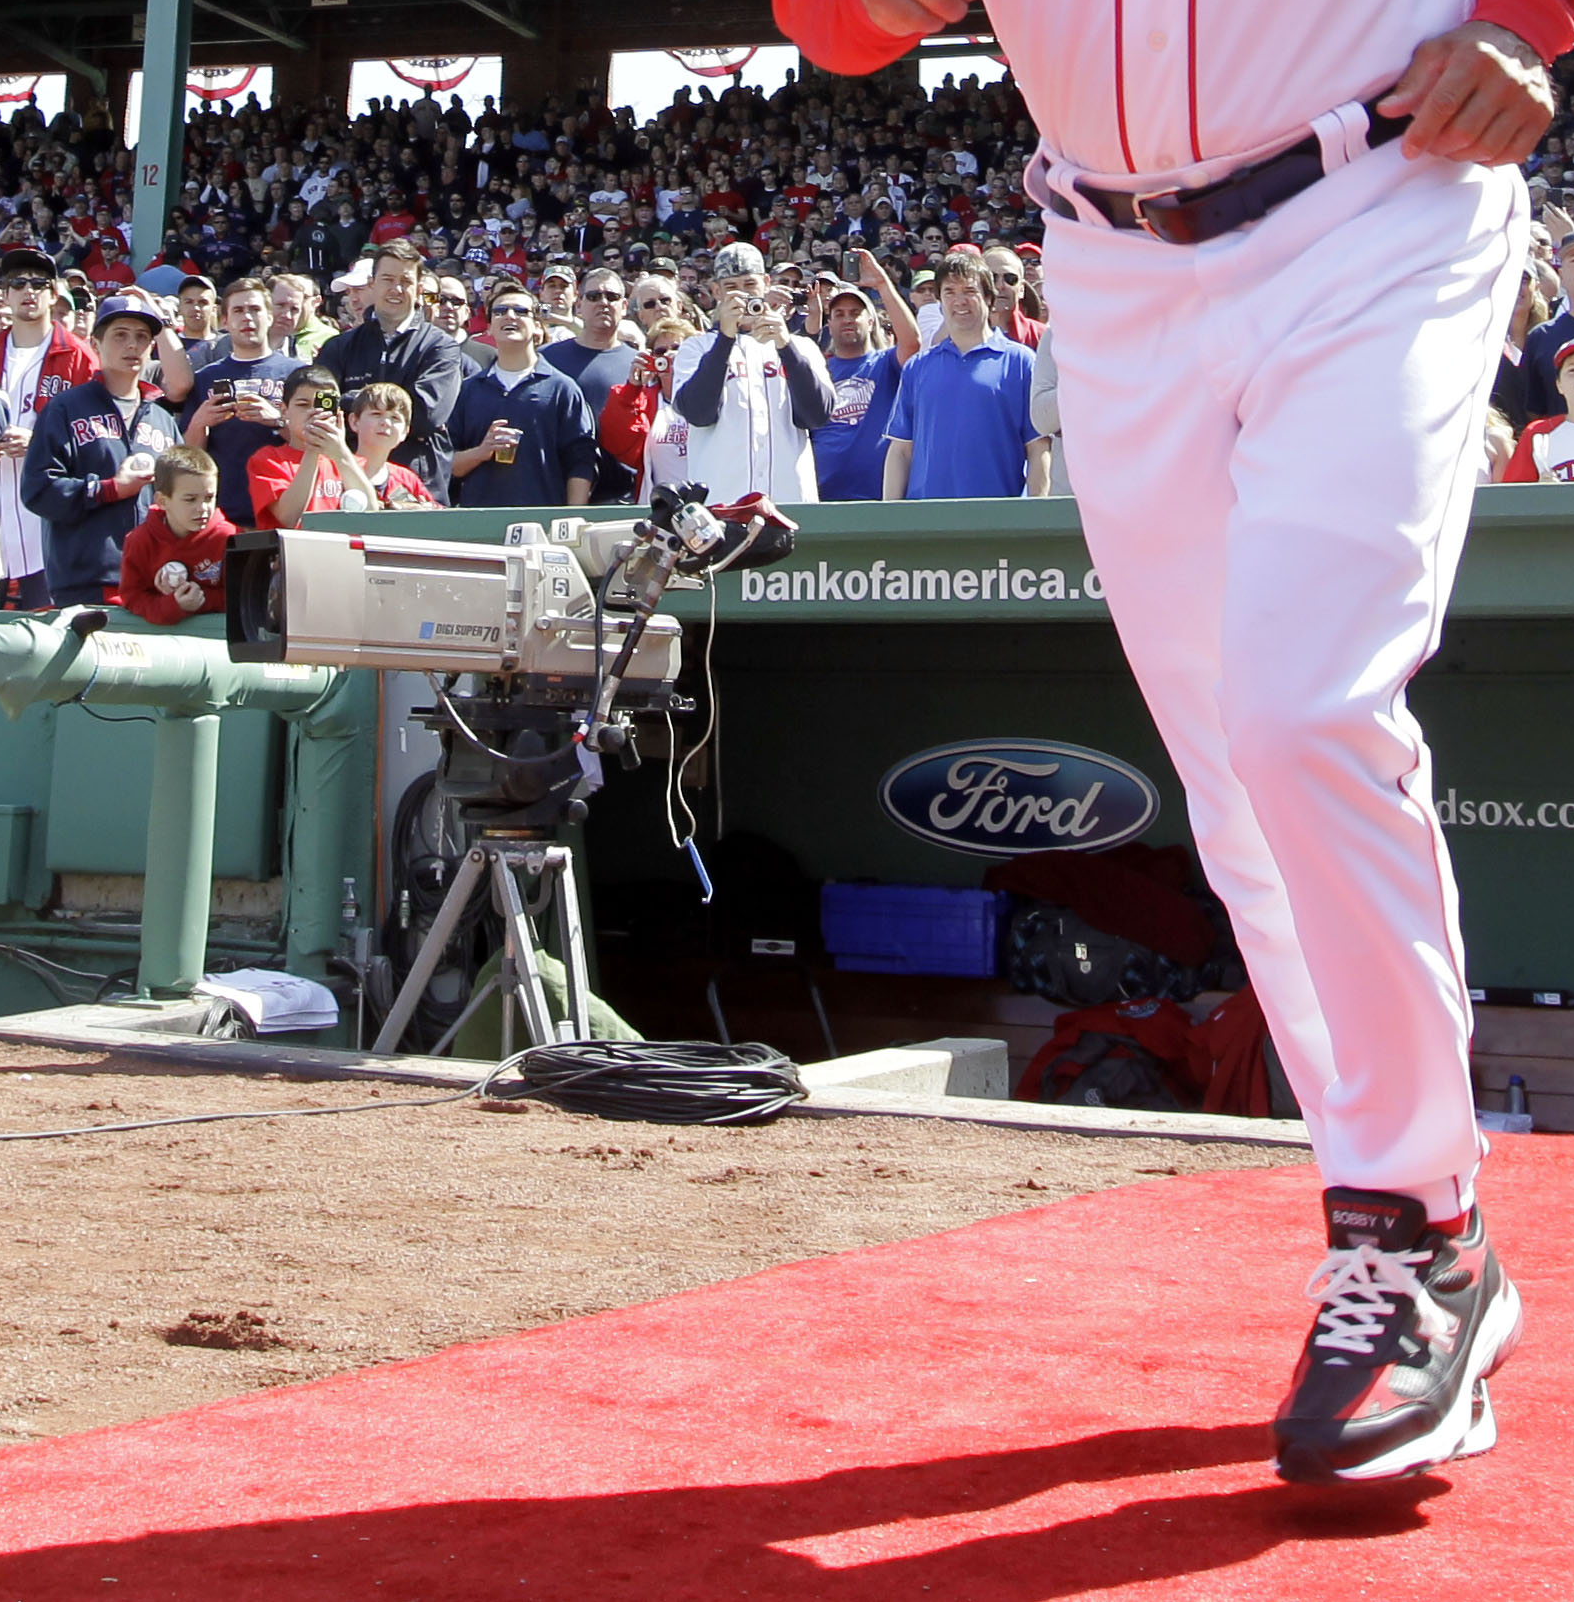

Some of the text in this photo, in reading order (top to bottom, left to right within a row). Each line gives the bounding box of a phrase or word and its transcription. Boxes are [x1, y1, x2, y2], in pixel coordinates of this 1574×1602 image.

[142, 164, 160, 186] 12
[72, 414, 123, 445] RED
[511, 526, 523, 544] 5
[559, 522, 569, 540] 8
[553, 578, 569, 597] 5
[435, 621, 454, 636] DIGI
[482, 626, 500, 644] 70
[928, 755, 1105, 838] Ford
[1332, 1209, 1379, 1229] BOBBY
[1384, 1216, 1396, 1231] V
